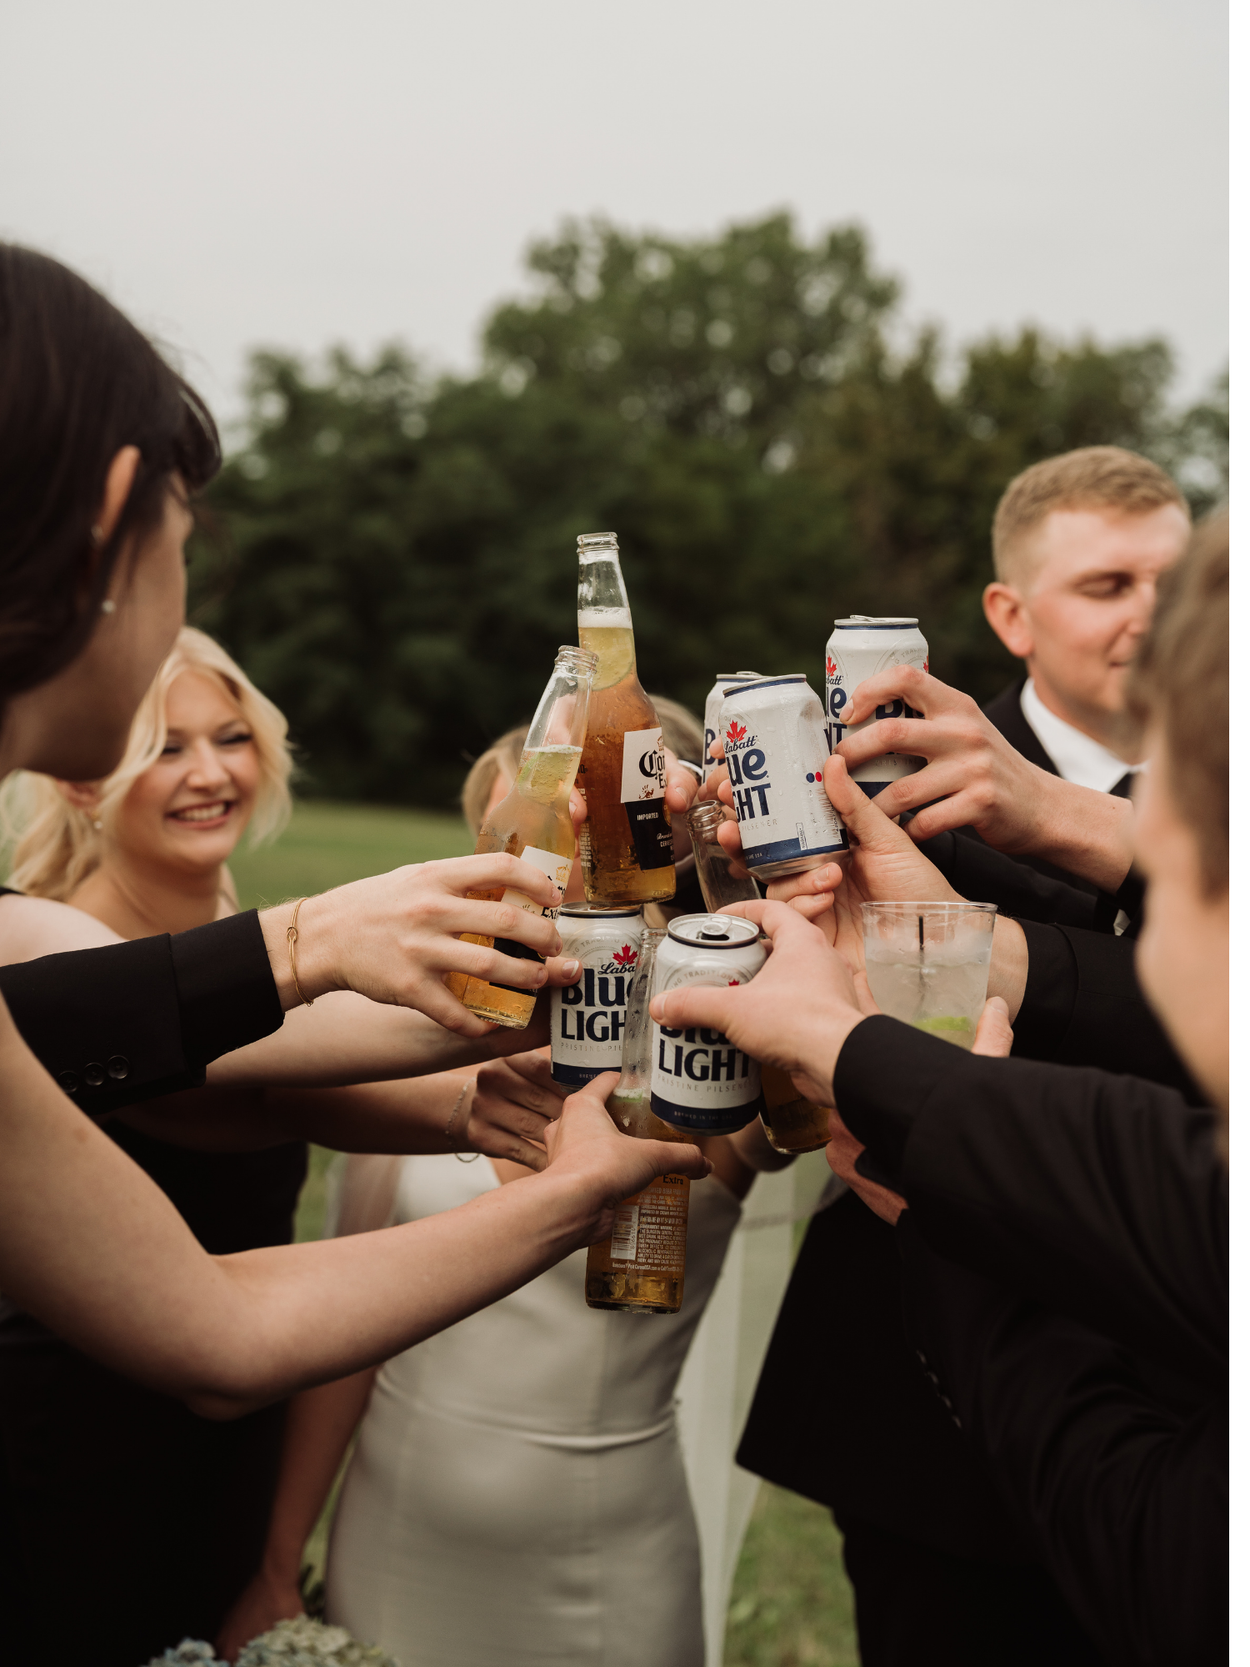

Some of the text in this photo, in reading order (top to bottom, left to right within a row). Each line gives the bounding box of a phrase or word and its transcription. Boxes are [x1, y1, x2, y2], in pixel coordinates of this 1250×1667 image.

[637, 812, 659, 821] IMPORTED
[657, 1073, 699, 1092] PRISTINE
[662, 1173, 684, 1185] Extra
